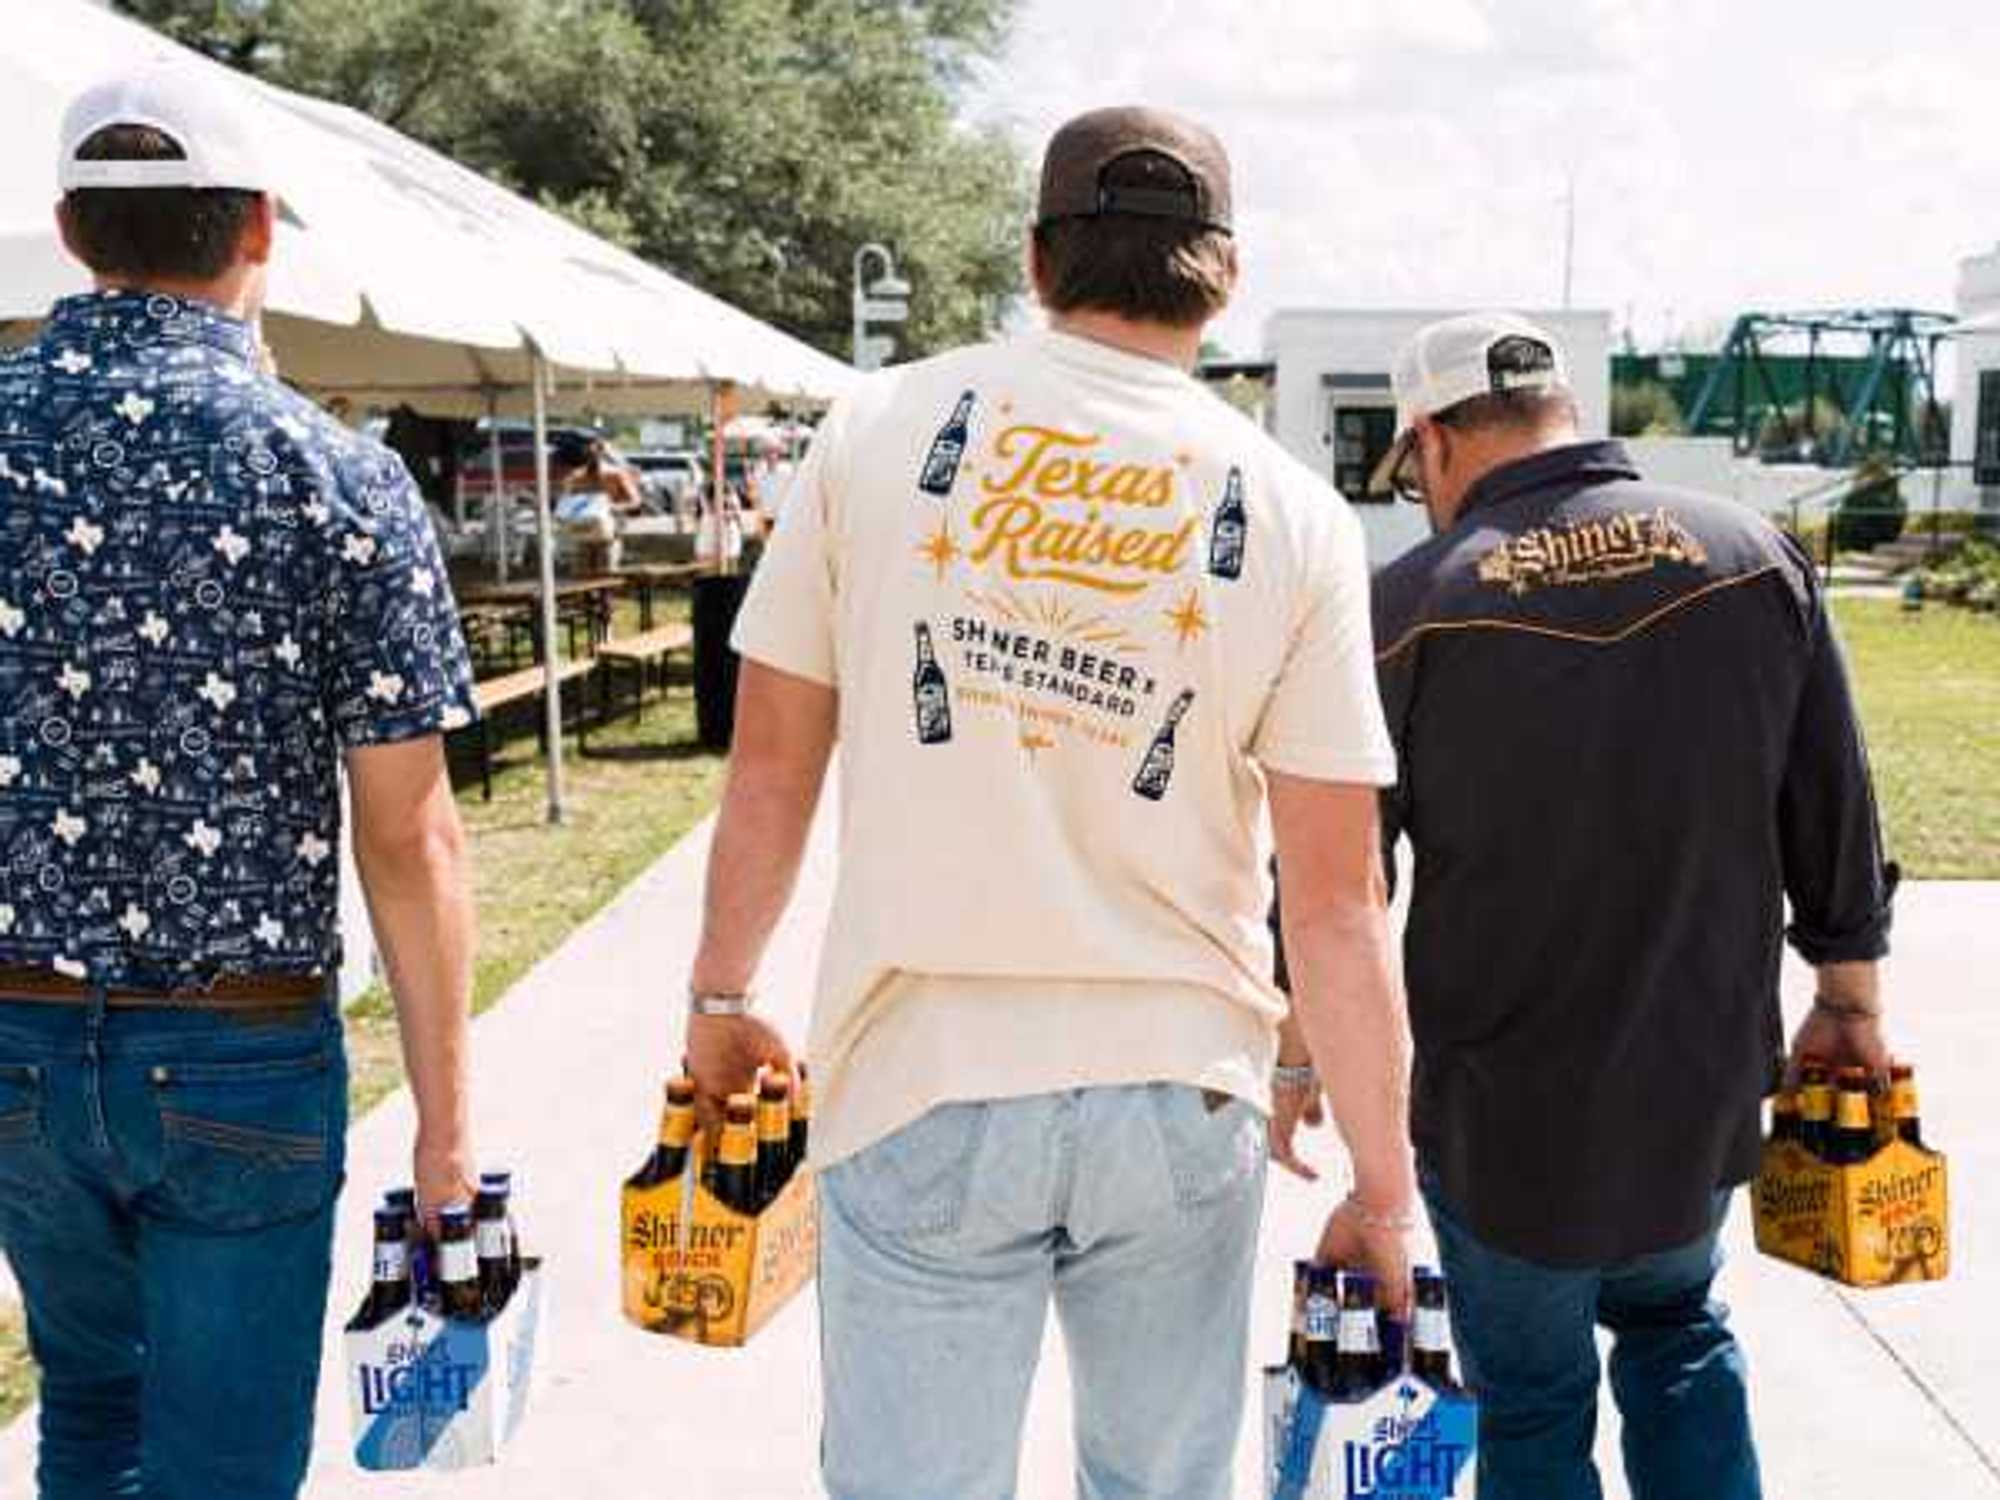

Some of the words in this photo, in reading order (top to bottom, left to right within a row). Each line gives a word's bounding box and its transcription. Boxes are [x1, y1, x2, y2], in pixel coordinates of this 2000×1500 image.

[981, 424, 1176, 507] Texas
[969, 496, 1199, 592] Raised
[1513, 511, 1649, 579] Shiner
[952, 617, 1052, 664] SHNER
[1060, 648, 1137, 691] BEER
[1021, 668, 1136, 716] STANDARD
[360, 1363, 478, 1415] LIGHT
[1344, 1440, 1469, 1500] LIGHT
